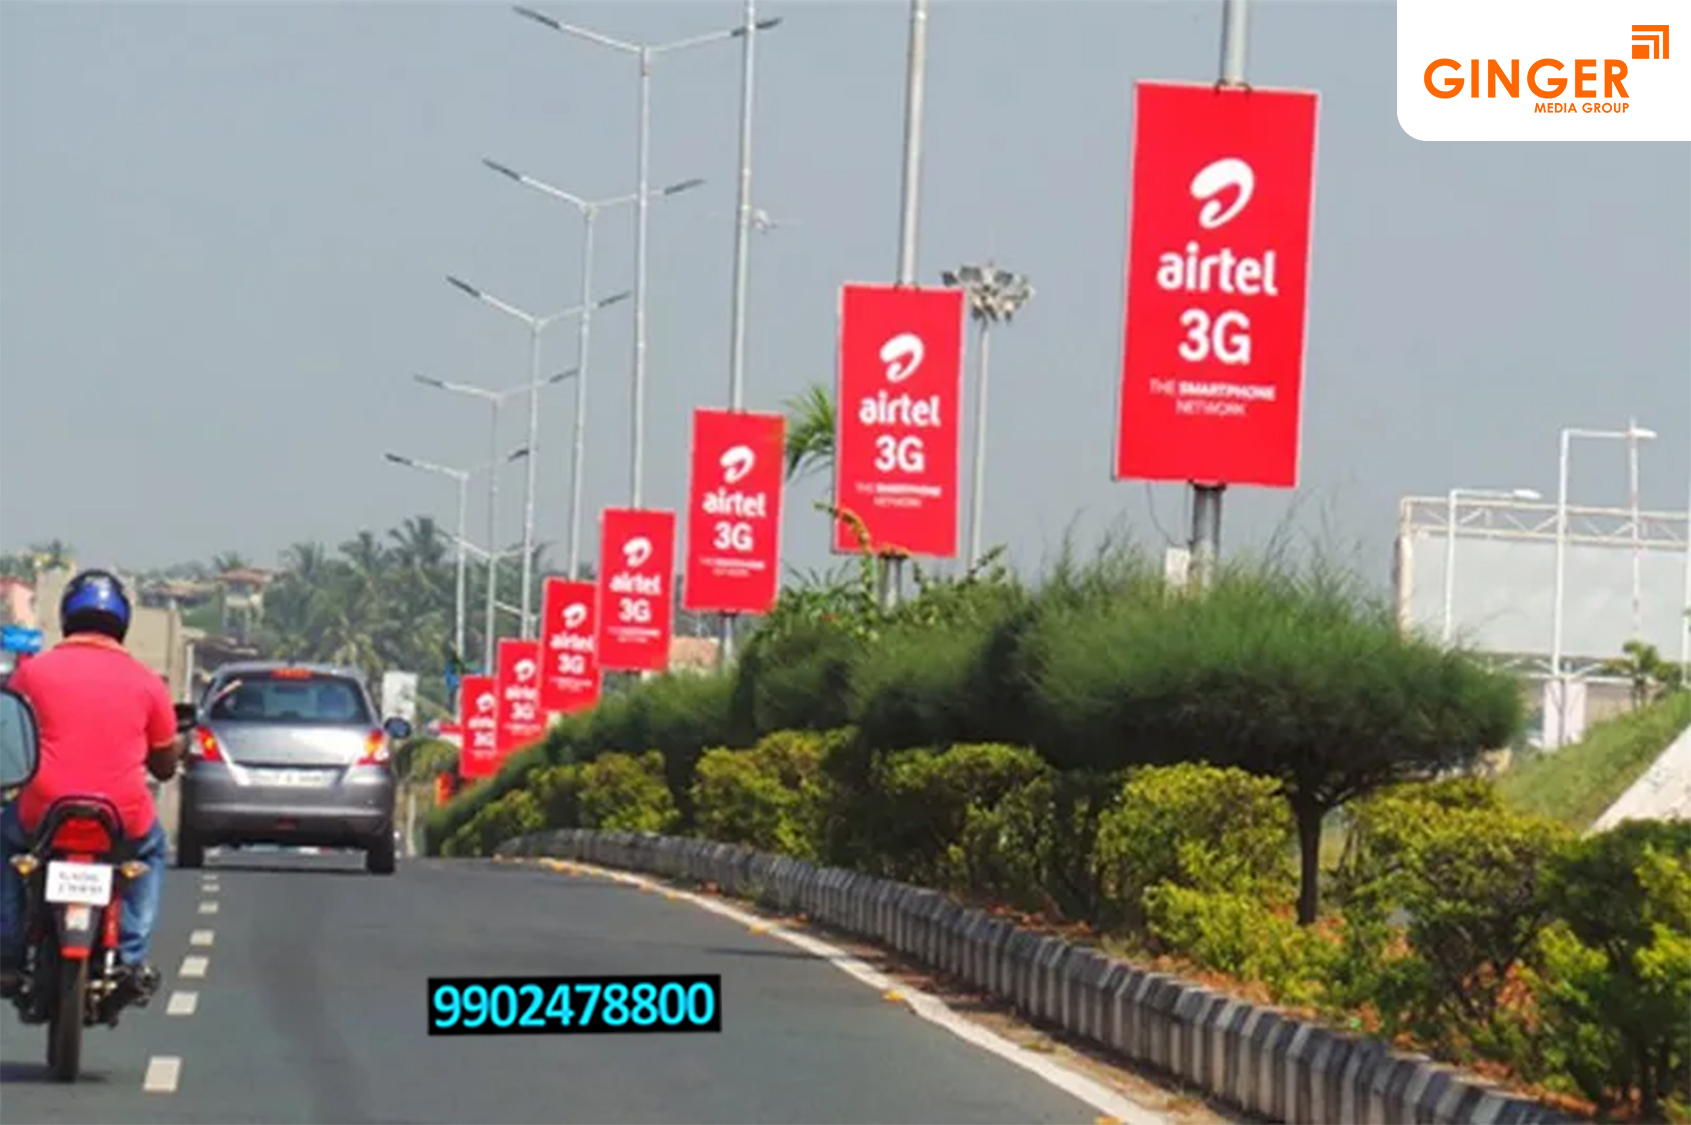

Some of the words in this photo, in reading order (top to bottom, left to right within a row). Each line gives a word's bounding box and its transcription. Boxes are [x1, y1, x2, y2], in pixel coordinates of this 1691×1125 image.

[1156, 240, 1279, 296] airtel
[1178, 308, 1252, 365] 3G
[1149, 377, 1177, 395] THE
[1178, 380, 1277, 401] SMARTPHONE
[858, 389, 942, 428] airtel
[874, 434, 926, 474] 3G
[702, 486, 766, 518] airtel
[713, 521, 754, 552] 3G
[609, 572, 662, 596] airtel
[617, 597, 652, 623] 3G
